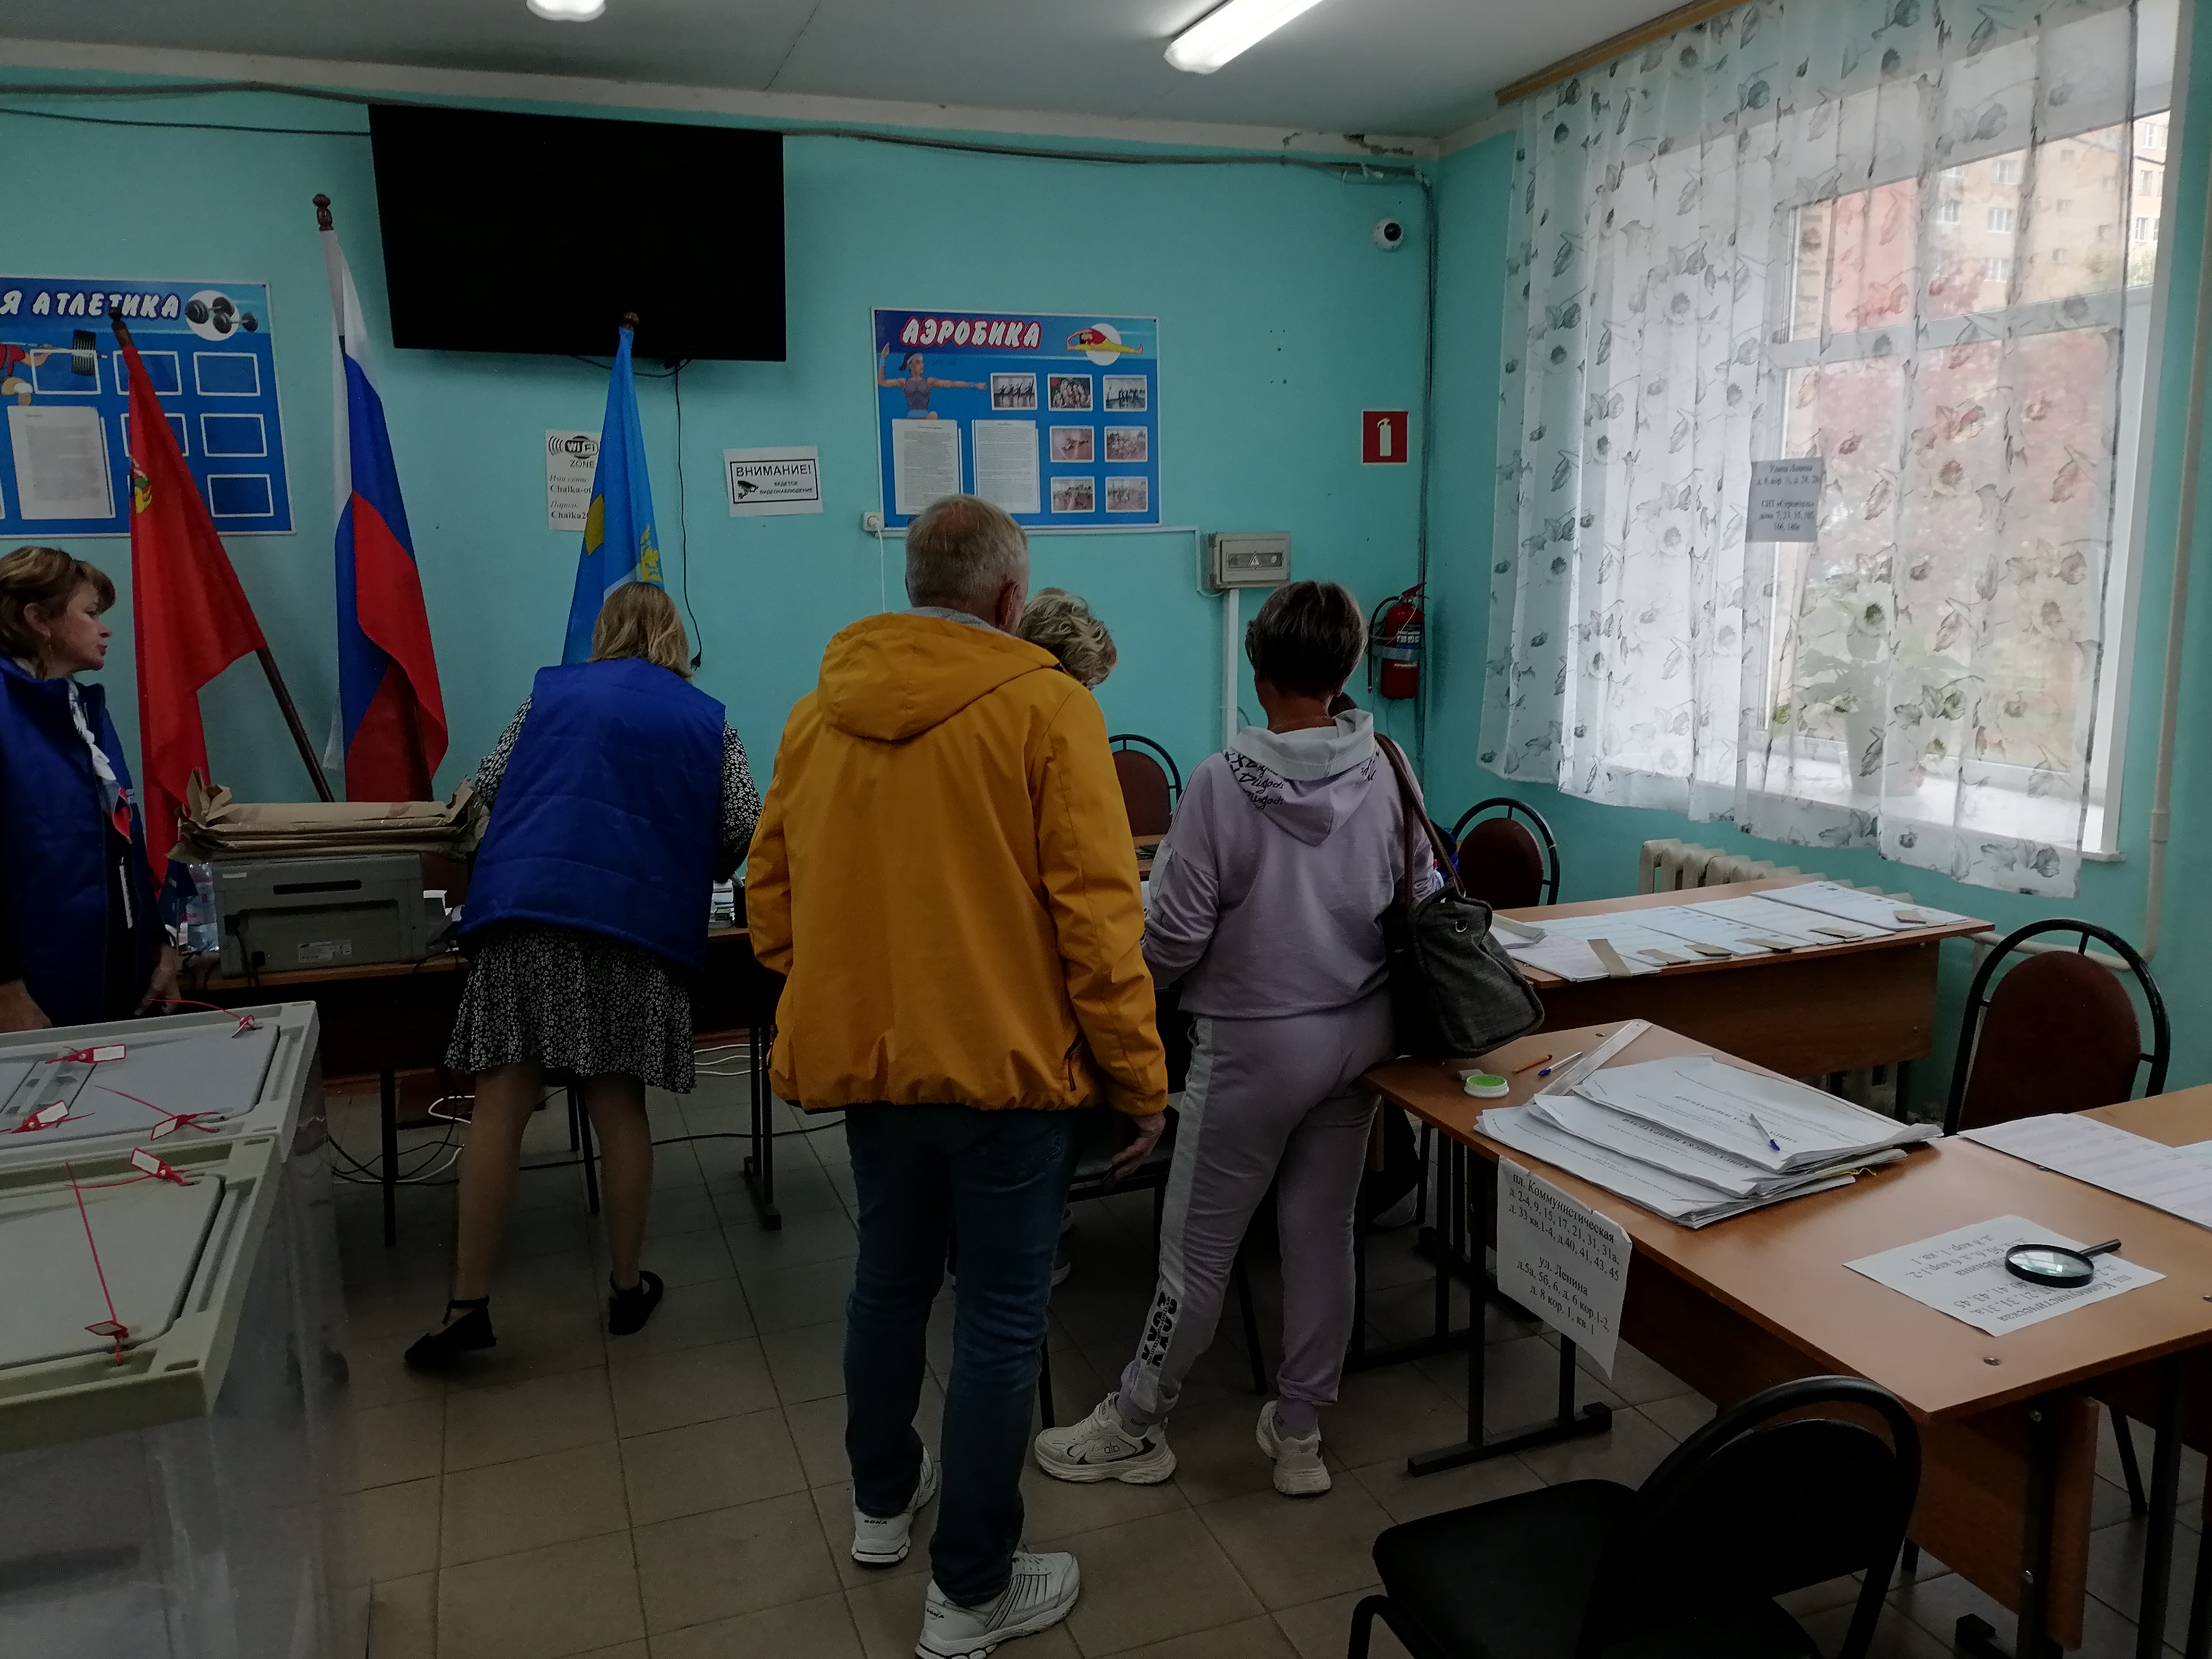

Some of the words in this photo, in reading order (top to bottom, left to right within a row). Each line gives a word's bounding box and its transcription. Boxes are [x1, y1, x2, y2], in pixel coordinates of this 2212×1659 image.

[0, 291, 22, 315] Я
[902, 318, 1040, 348] АЭРОБИКА
[570, 460, 595, 468] ZONE
[736, 464, 811, 477] ВНИМАНИЕ!
[551, 510, 588, 520] Chaika2
[1513, 1174, 1526, 1188] пл.
[1528, 1179, 1614, 1243] Коммунистическая
[1545, 1208, 1555, 1225] 15,
[1559, 1217, 1570, 1233] 17,
[1573, 1225, 1585, 1243] 21,
[1588, 1234, 1600, 1252] 31,
[1602, 1244, 1620, 1266] 31а,
[1580, 1247, 1592, 1265] 41,
[1594, 1257, 1607, 1274] 43,
[1609, 1267, 1618, 1281] 45
[1539, 1257, 1552, 1271] ул.
[1554, 1264, 1588, 1297] Ленина
[1540, 1288, 1546, 1300] 8
[1548, 1296, 1564, 1313] кор.
[1572, 1294, 1578, 1305] 6
